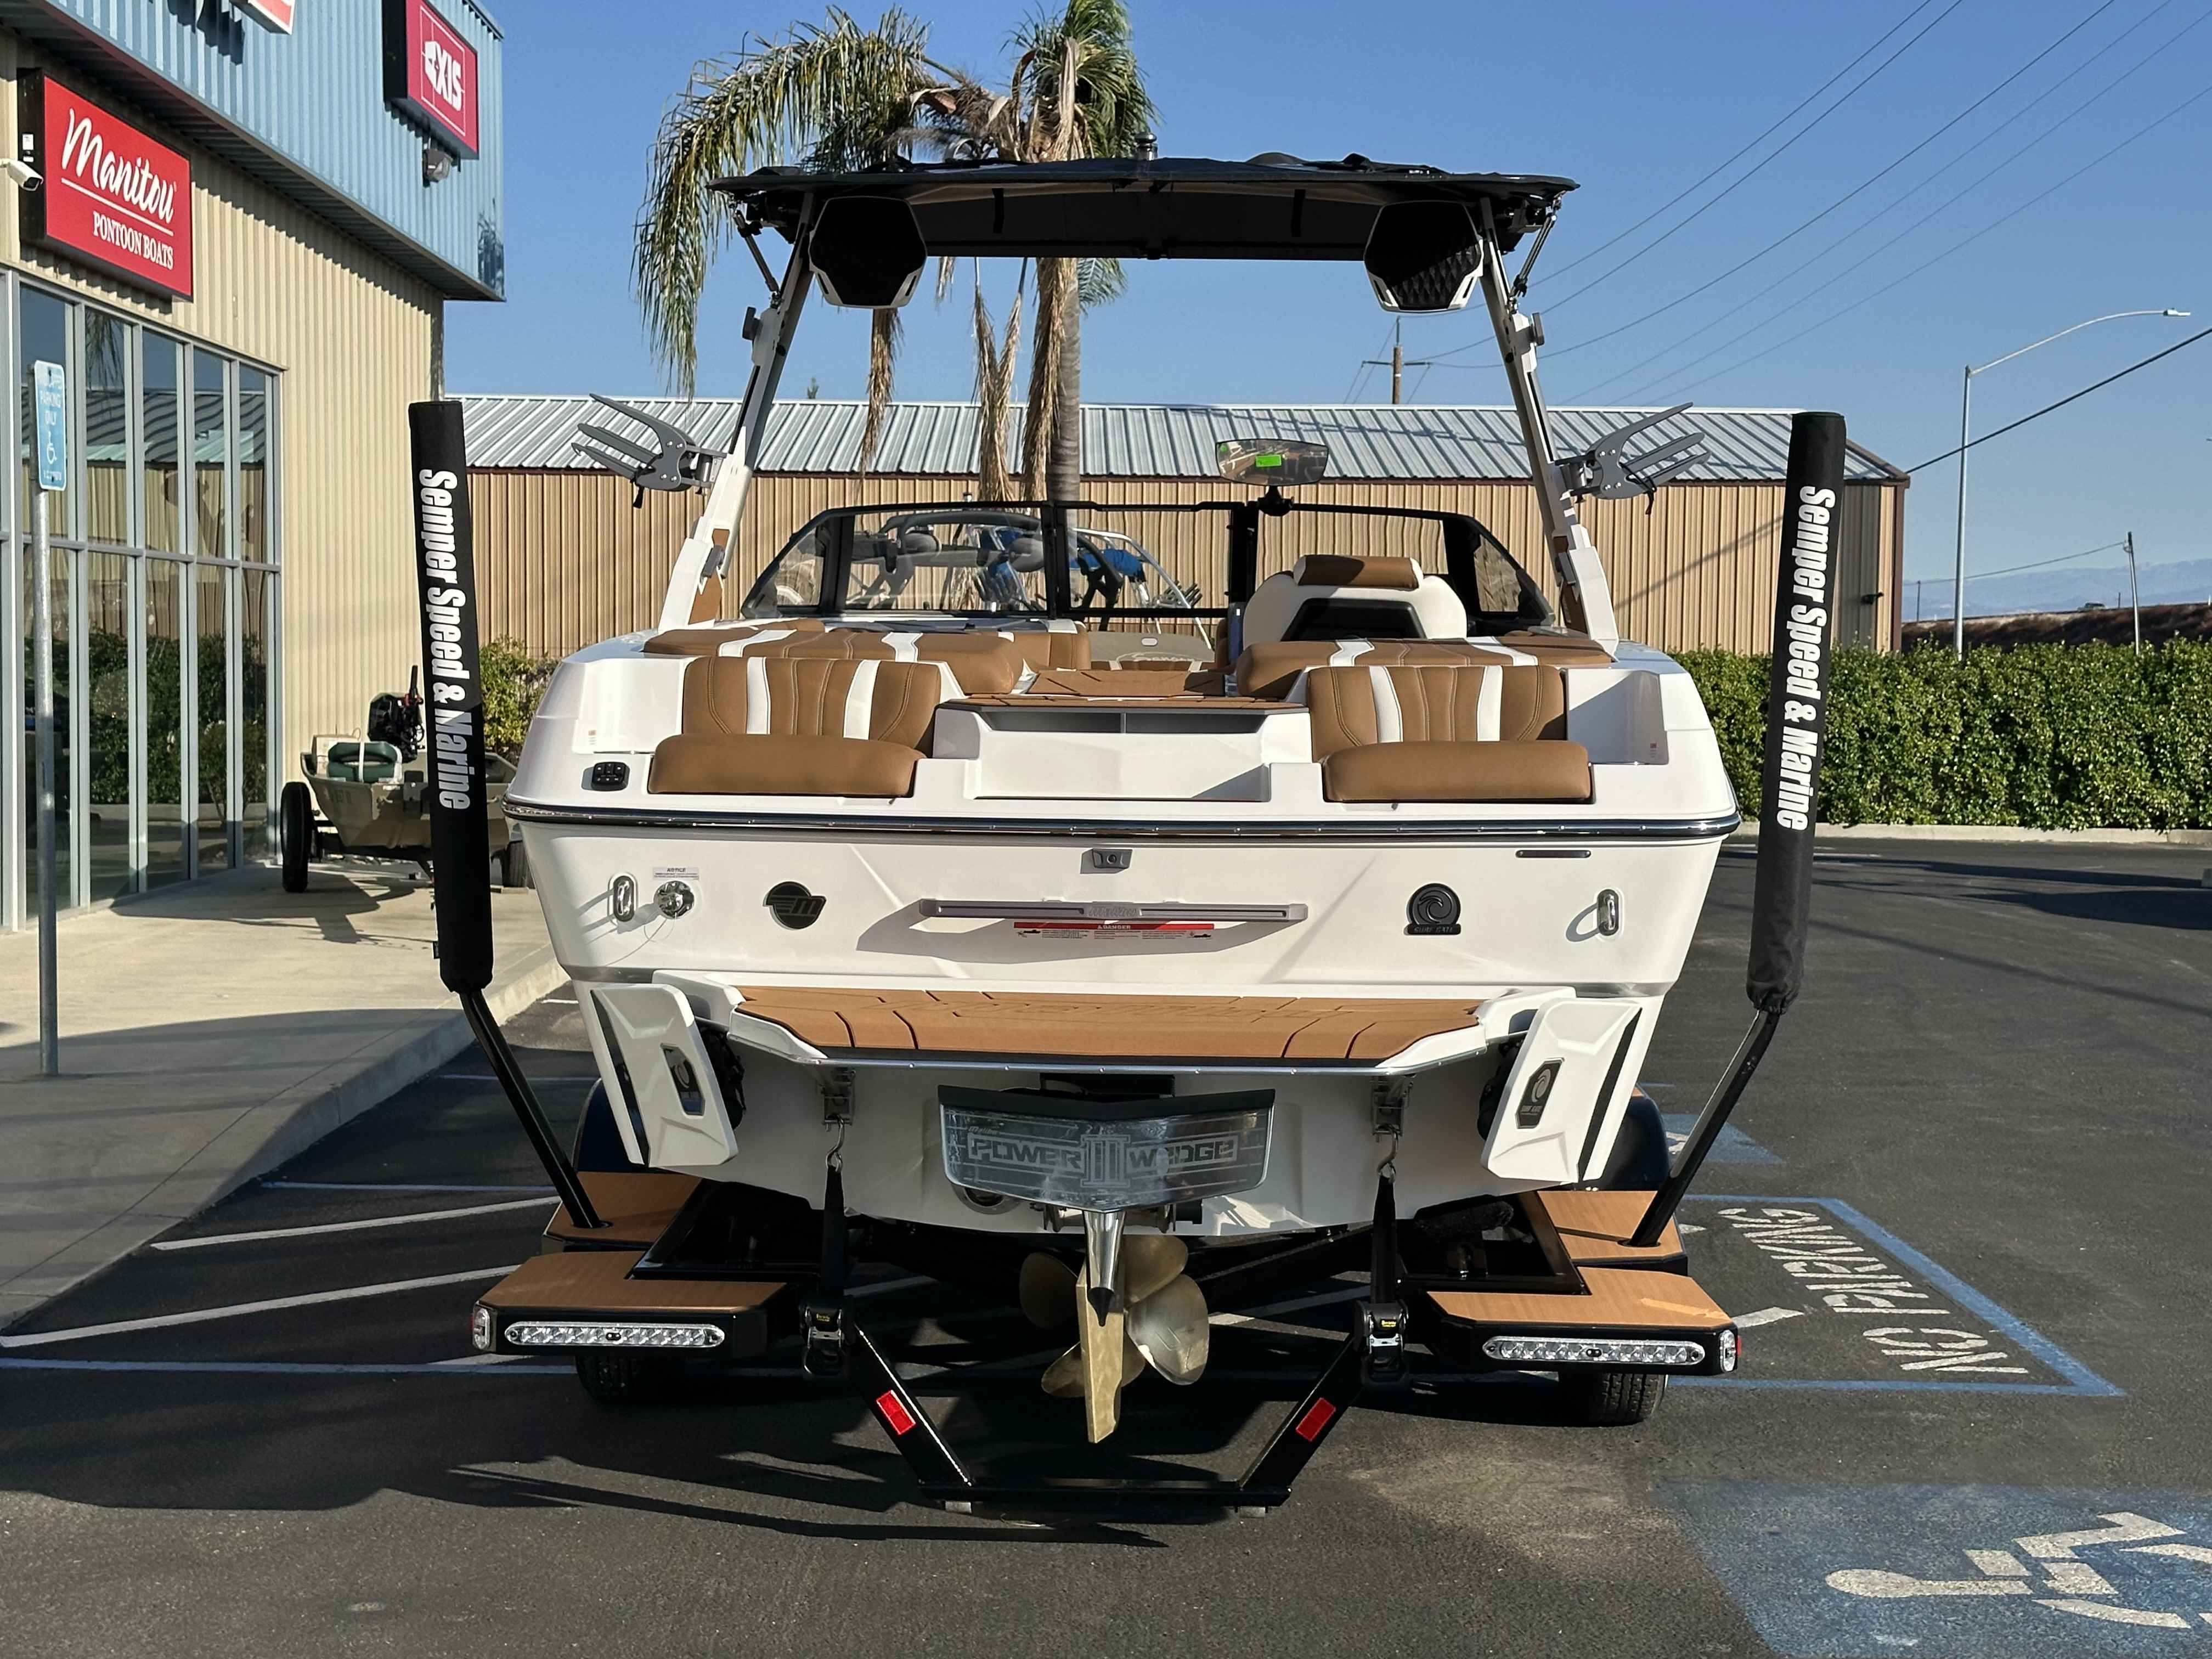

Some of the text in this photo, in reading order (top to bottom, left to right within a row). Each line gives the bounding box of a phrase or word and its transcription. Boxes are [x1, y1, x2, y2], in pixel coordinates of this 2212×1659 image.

[61, 108, 174, 224] Manitou
[93, 210, 174, 270] PONTOON BOATS
[419, 469, 475, 809] Semper Speed & Marine
[1776, 486, 1836, 831] Semper Speed & Marine
[972, 1137, 1082, 1170] POWER
